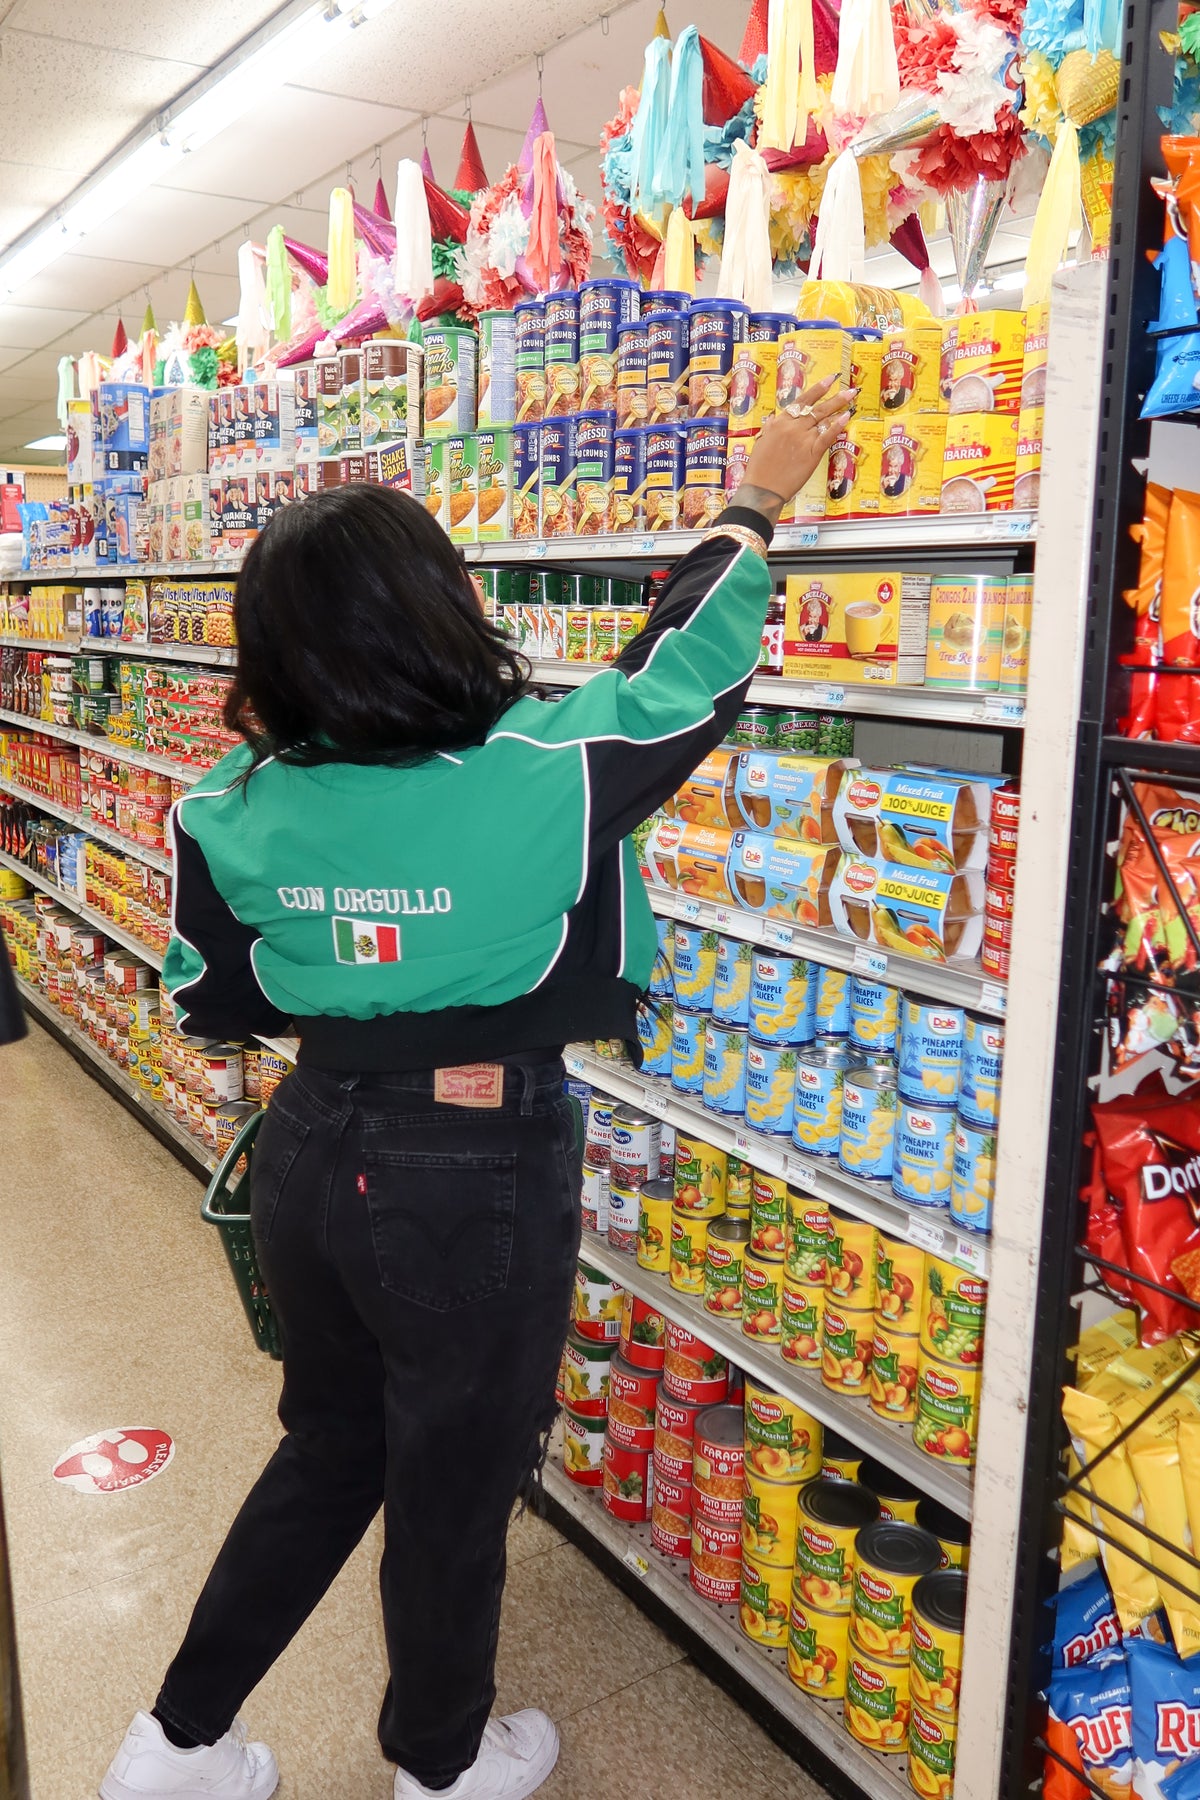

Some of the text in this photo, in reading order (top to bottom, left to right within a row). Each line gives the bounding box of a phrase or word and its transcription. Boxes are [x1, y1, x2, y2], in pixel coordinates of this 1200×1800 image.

[586, 321, 611, 329] CRUMBS
[552, 331, 576, 339] CRUMBS
[699, 343, 725, 352] CRUMBS
[954, 344, 992, 360] IBARRA
[652, 351, 674, 359] CRUMBS
[686, 435, 725, 451] PROGRESSO
[382, 447, 404, 463] SHAKE
[583, 450, 607, 459] CRUMBS
[944, 448, 982, 460] IBARRA
[653, 460, 677, 468] CRUMBS
[700, 456, 726, 466] CRUMBS
[387, 461, 405, 479] BAKE
[802, 591, 829, 602] ABUELITA
[939, 652, 957, 662] Tres
[783, 723, 793, 731] EL
[742, 754, 748, 762] 4
[750, 770, 766, 780] Dole
[774, 774, 803, 784] mandarin
[772, 782, 797, 792] oranges
[896, 784, 944, 799] Mixed Fruit
[859, 789, 878, 800] Monte
[889, 798, 946, 817] 100% JUICE
[700, 829, 715, 838] Diced
[694, 836, 715, 847] Peaches
[745, 850, 761, 862] Dole
[770, 856, 800, 868] mandarin
[769, 864, 793, 875] oranges
[856, 873, 875, 883] Monte
[891, 870, 939, 887] Mixed Fruit
[884, 883, 941, 905] 100% JUICE
[277, 887, 452, 914] CON ORGULLO
[758, 963, 775, 975] Dole
[753, 981, 782, 994] PINEAPPLE
[756, 991, 775, 1001] SLICES
[855, 995, 874, 1007] SLICES
[933, 1016, 956, 1029] Dole
[922, 1037, 963, 1049] PINEAPPLE
[925, 1047, 958, 1058] CHUNKS
[801, 1070, 817, 1084] Dole
[845, 1088, 859, 1102] Dole
[798, 1099, 817, 1111] SLICES
[910, 1115, 931, 1130] Dole
[902, 1134, 940, 1150] PINEAPPLE
[905, 1145, 935, 1159] CHUNKS
[1144, 1158, 1200, 1203] Dori
[756, 1187, 772, 1198] Monte
[757, 1211, 780, 1220] Cocktail
[805, 1214, 816, 1222] Del
[798, 1235, 814, 1244] Fruit
[713, 1252, 731, 1262] Monte
[713, 1272, 738, 1282] Cocktail
[749, 1272, 766, 1283] Monte
[959, 1283, 972, 1293] Del
[749, 1295, 772, 1305] Cocktail
[788, 1294, 806, 1308] Monte
[951, 1303, 970, 1314] Fruit
[786, 1319, 813, 1330] Cocktail
[829, 1340, 848, 1354] Halves
[671, 1378, 692, 1390] BEANS
[926, 1373, 958, 1392] Del Monte
[920, 1390, 964, 1414] Fruit Cocktail
[752, 1401, 780, 1416] Del Monte
[618, 1424, 636, 1437] BEANS
[762, 1429, 788, 1440] Peaches
[703, 1446, 744, 1462] FARAON
[104, 1442, 166, 1490] PLEASE WAIT
[662, 1455, 683, 1470] BEANS
[701, 1495, 720, 1510] PINTO
[696, 1521, 736, 1543] FARAON
[658, 1531, 678, 1546] BEANS
[804, 1529, 834, 1550] Del Monte
[812, 1559, 840, 1574] Peaches
[693, 1569, 736, 1591] PINTO BEANS
[859, 1574, 891, 1597] Del Monte
[855, 1594, 896, 1622] Peach Halves
[917, 1656, 936, 1674] Halves
[853, 1665, 884, 1688] Del Monte
[848, 1683, 888, 1712] Peach Halves
[913, 1712, 942, 1738] Del Monte
[924, 1746, 946, 1766] Halves
